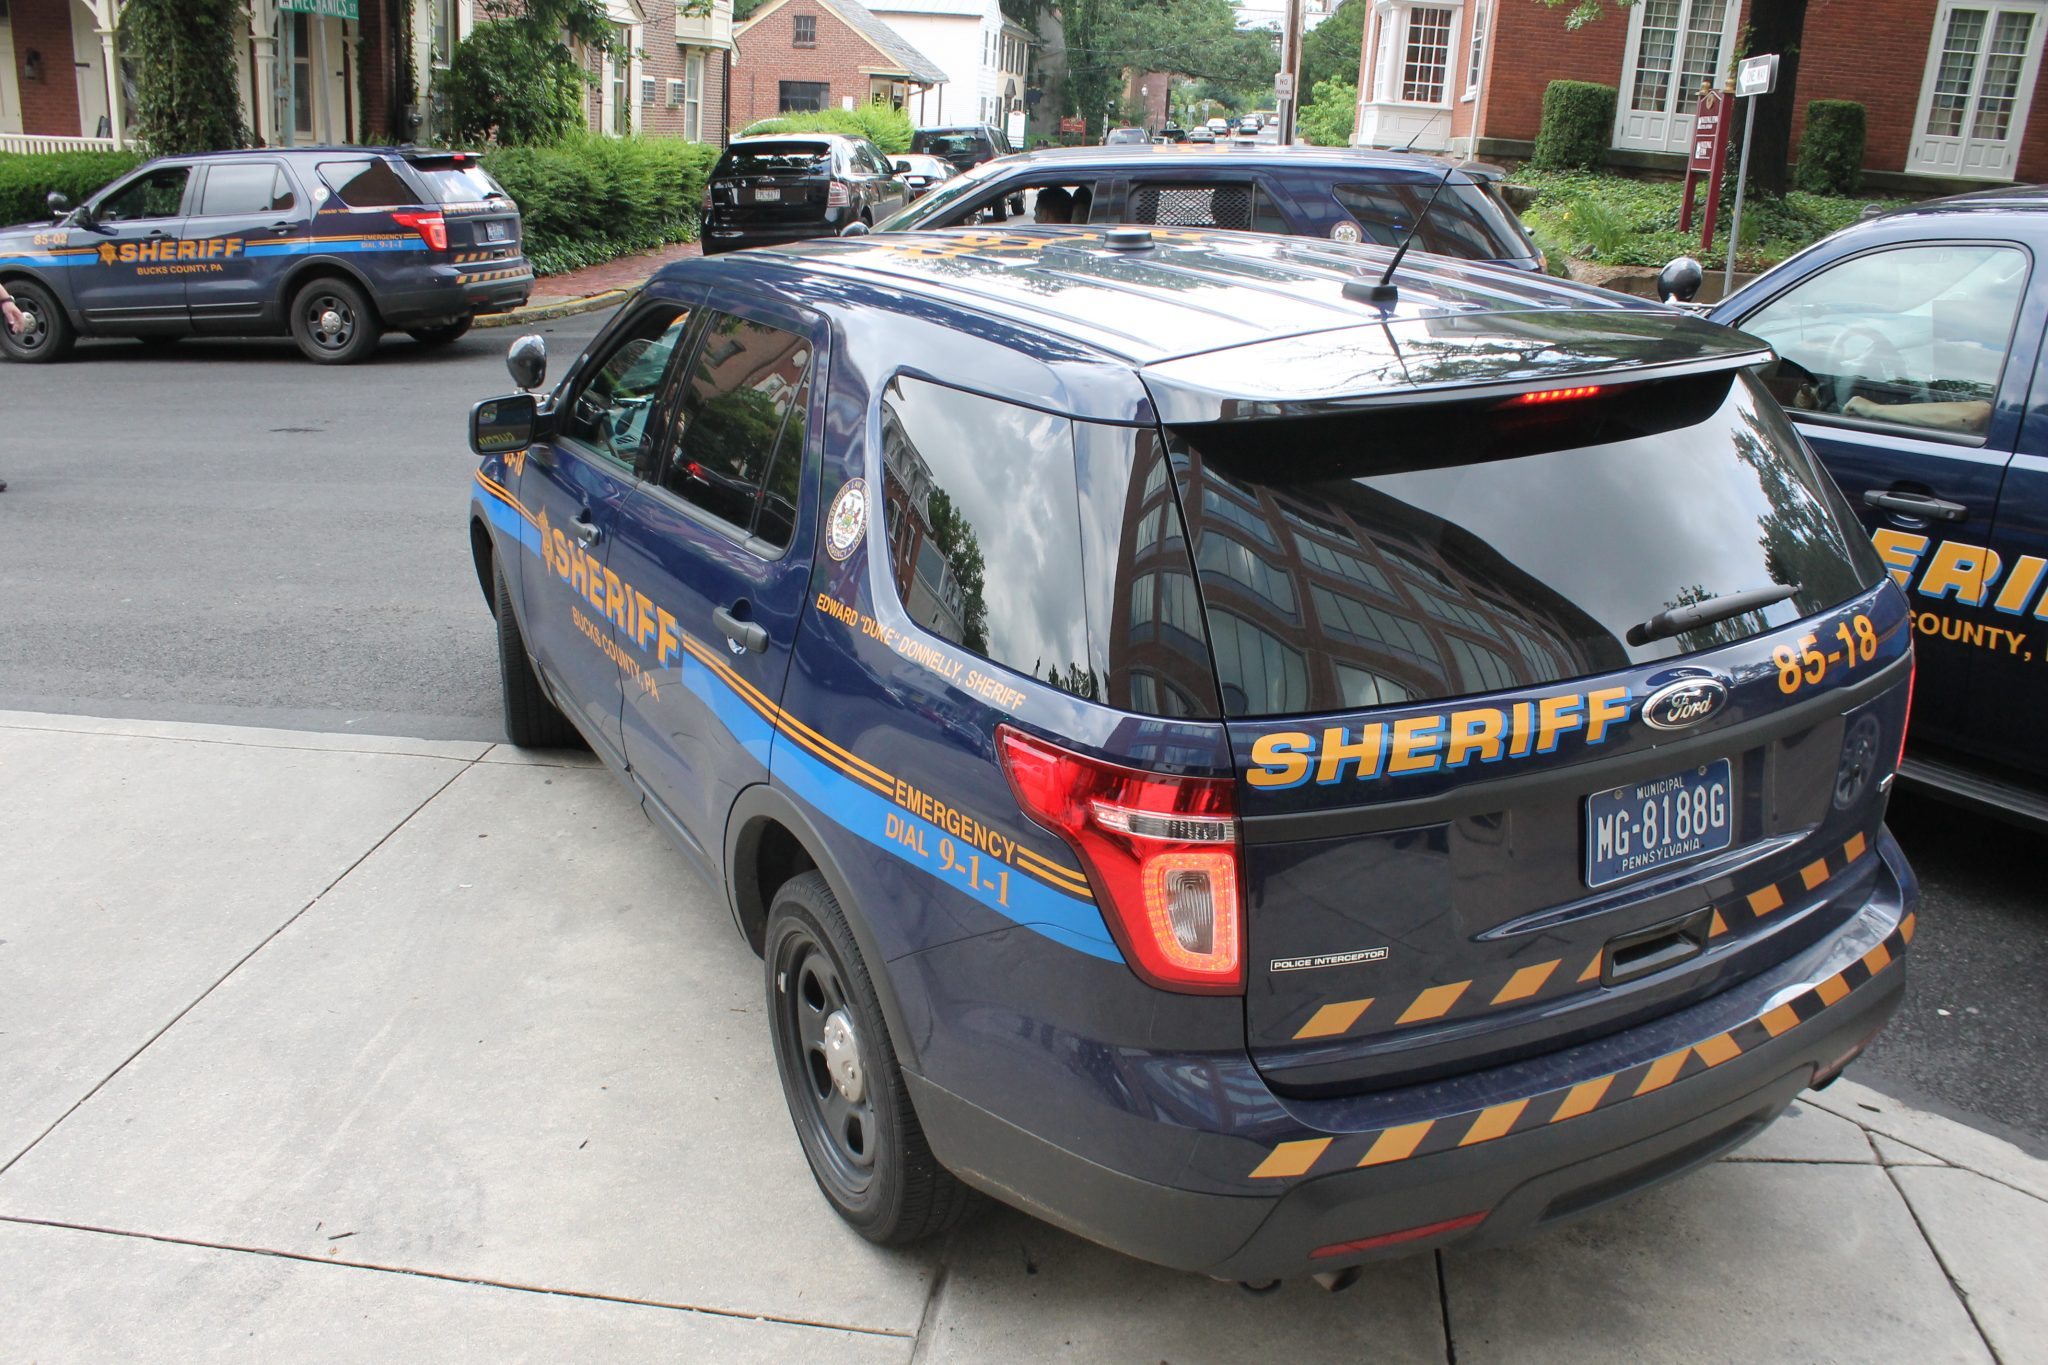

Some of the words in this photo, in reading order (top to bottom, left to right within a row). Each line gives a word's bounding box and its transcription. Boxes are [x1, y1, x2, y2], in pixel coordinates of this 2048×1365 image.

[33, 233, 69, 246] 85-02
[118, 238, 244, 263] SHERIFF
[137, 266, 168, 276] BUCKS
[170, 264, 209, 274] COUNTY,
[211, 263, 223, 272] PA
[552, 528, 680, 671] SHERIFF
[1871, 527, 2048, 622] ERI
[572, 606, 601, 648] BUCKS
[643, 671, 660, 703] PA
[816, 592, 859, 628] EDWARD
[899, 636, 963, 685] DONNELLY,
[965, 670, 1026, 710] SHERIFF
[1772, 614, 1878, 694] 85-18
[1246, 686, 1632, 791] SHERIFF
[1667, 688, 1713, 723] Ford
[894, 779, 1018, 866] EMERGENCY
[1597, 783, 1725, 863] MG-8188G
[1636, 776, 1685, 800] MUNICIPAL
[885, 813, 929, 858] DIAL
[939, 838, 1009, 908] 9-1-1
[1622, 838, 1700, 872] PENNSYLVANIA
[1274, 959, 1312, 969] POLICE
[1314, 950, 1385, 966] INTERCEPTOR
